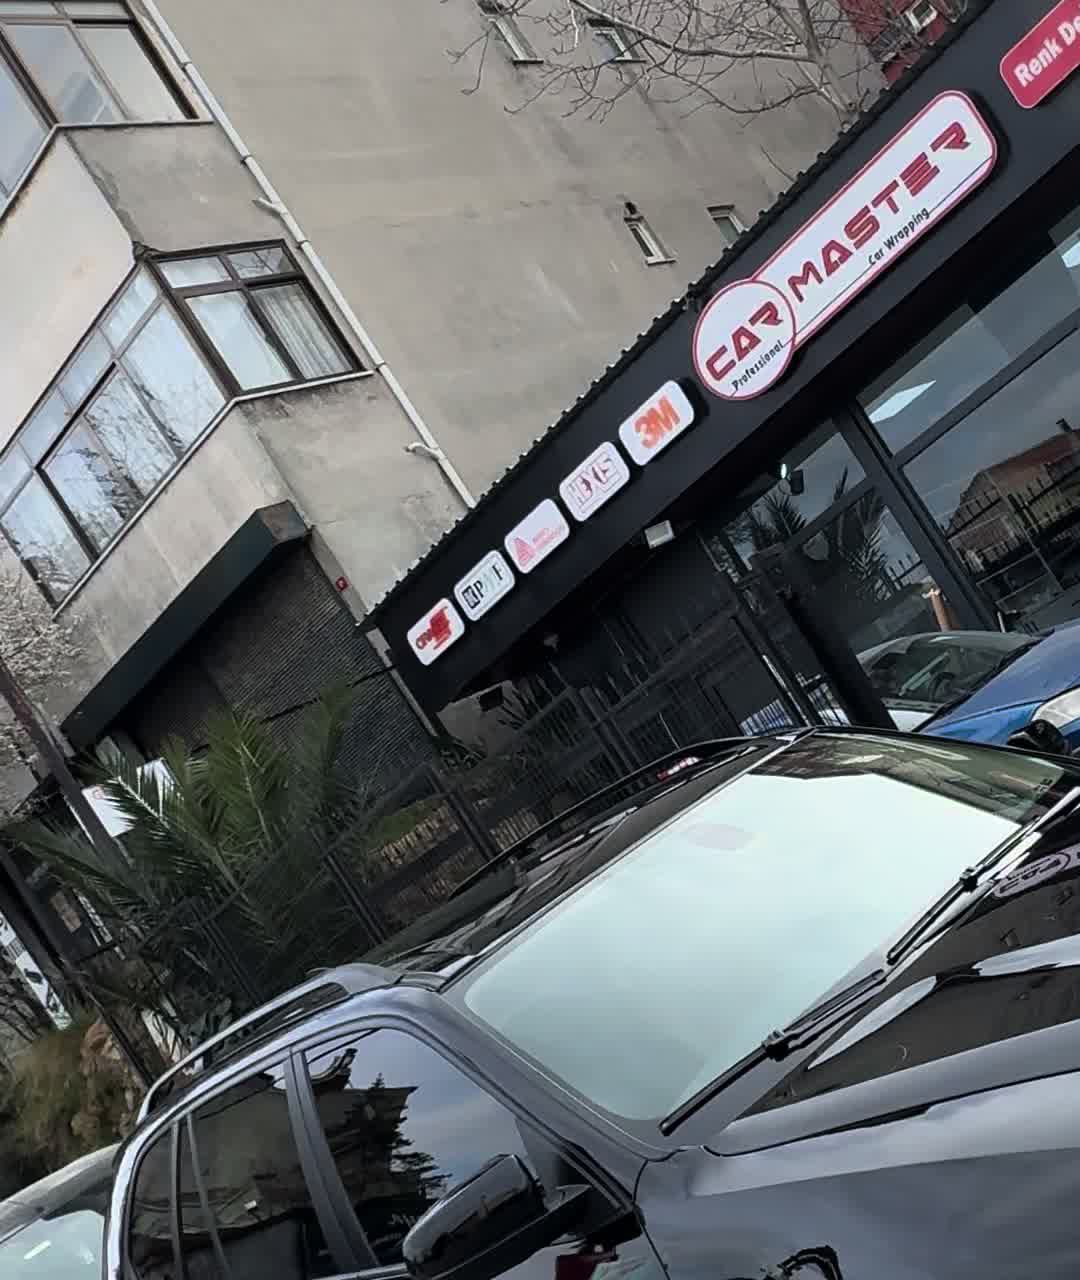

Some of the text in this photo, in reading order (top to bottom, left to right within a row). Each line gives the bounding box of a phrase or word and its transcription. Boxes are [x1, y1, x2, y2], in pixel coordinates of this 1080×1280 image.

[1013, 38, 1063, 88] Renk
[705, 121, 971, 382] CAR MASTER
[868, 207, 930, 266] Car Wrapping
[731, 340, 784, 391] Professional
[634, 394, 680, 449] 3M
